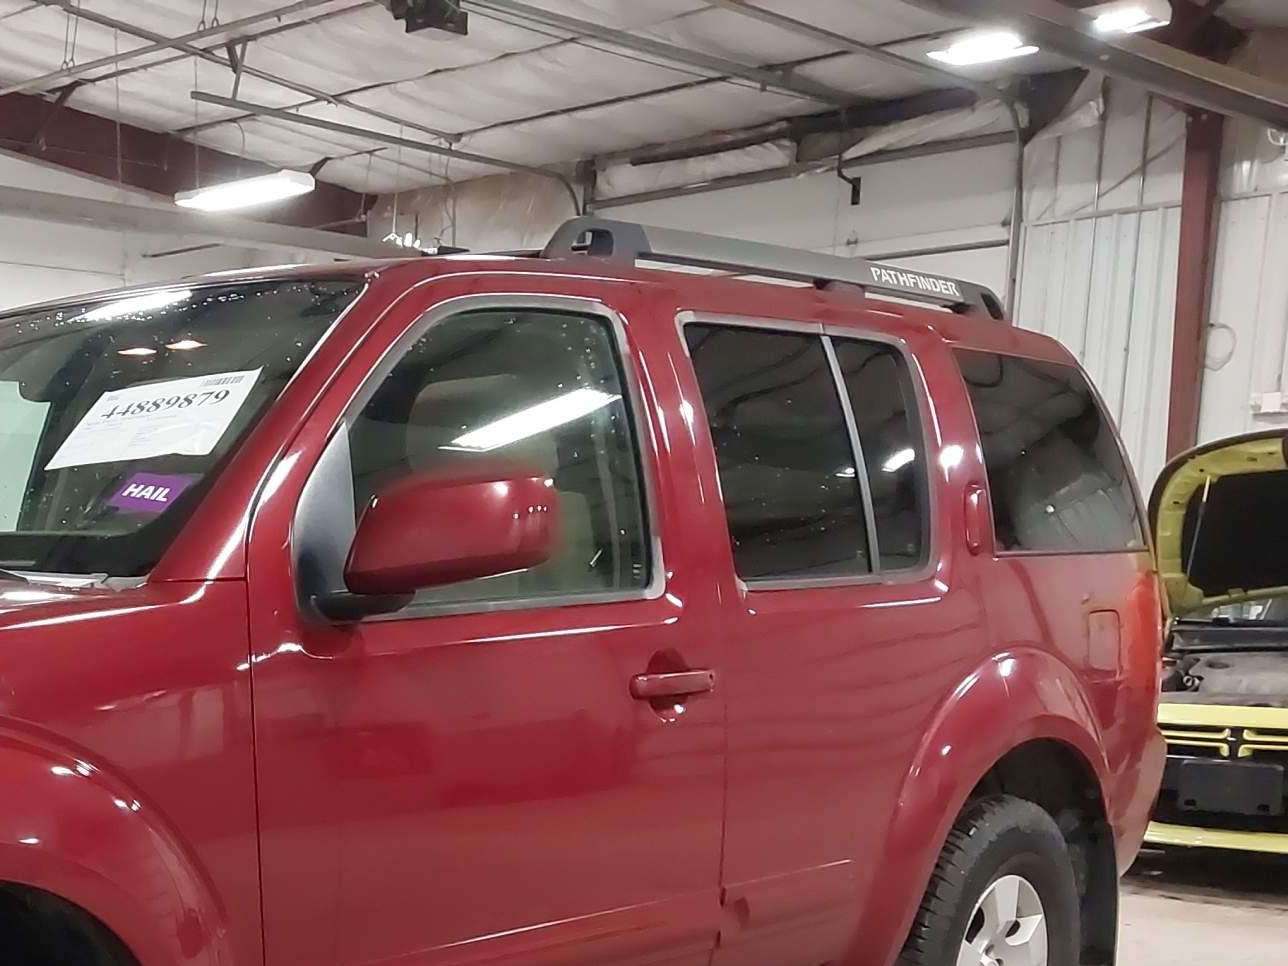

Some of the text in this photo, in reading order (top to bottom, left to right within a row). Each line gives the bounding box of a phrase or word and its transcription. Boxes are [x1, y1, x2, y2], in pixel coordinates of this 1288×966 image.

[870, 267, 960, 296] PATHFINDER
[100, 389, 231, 419] 44889879
[122, 483, 171, 502] HAIL
